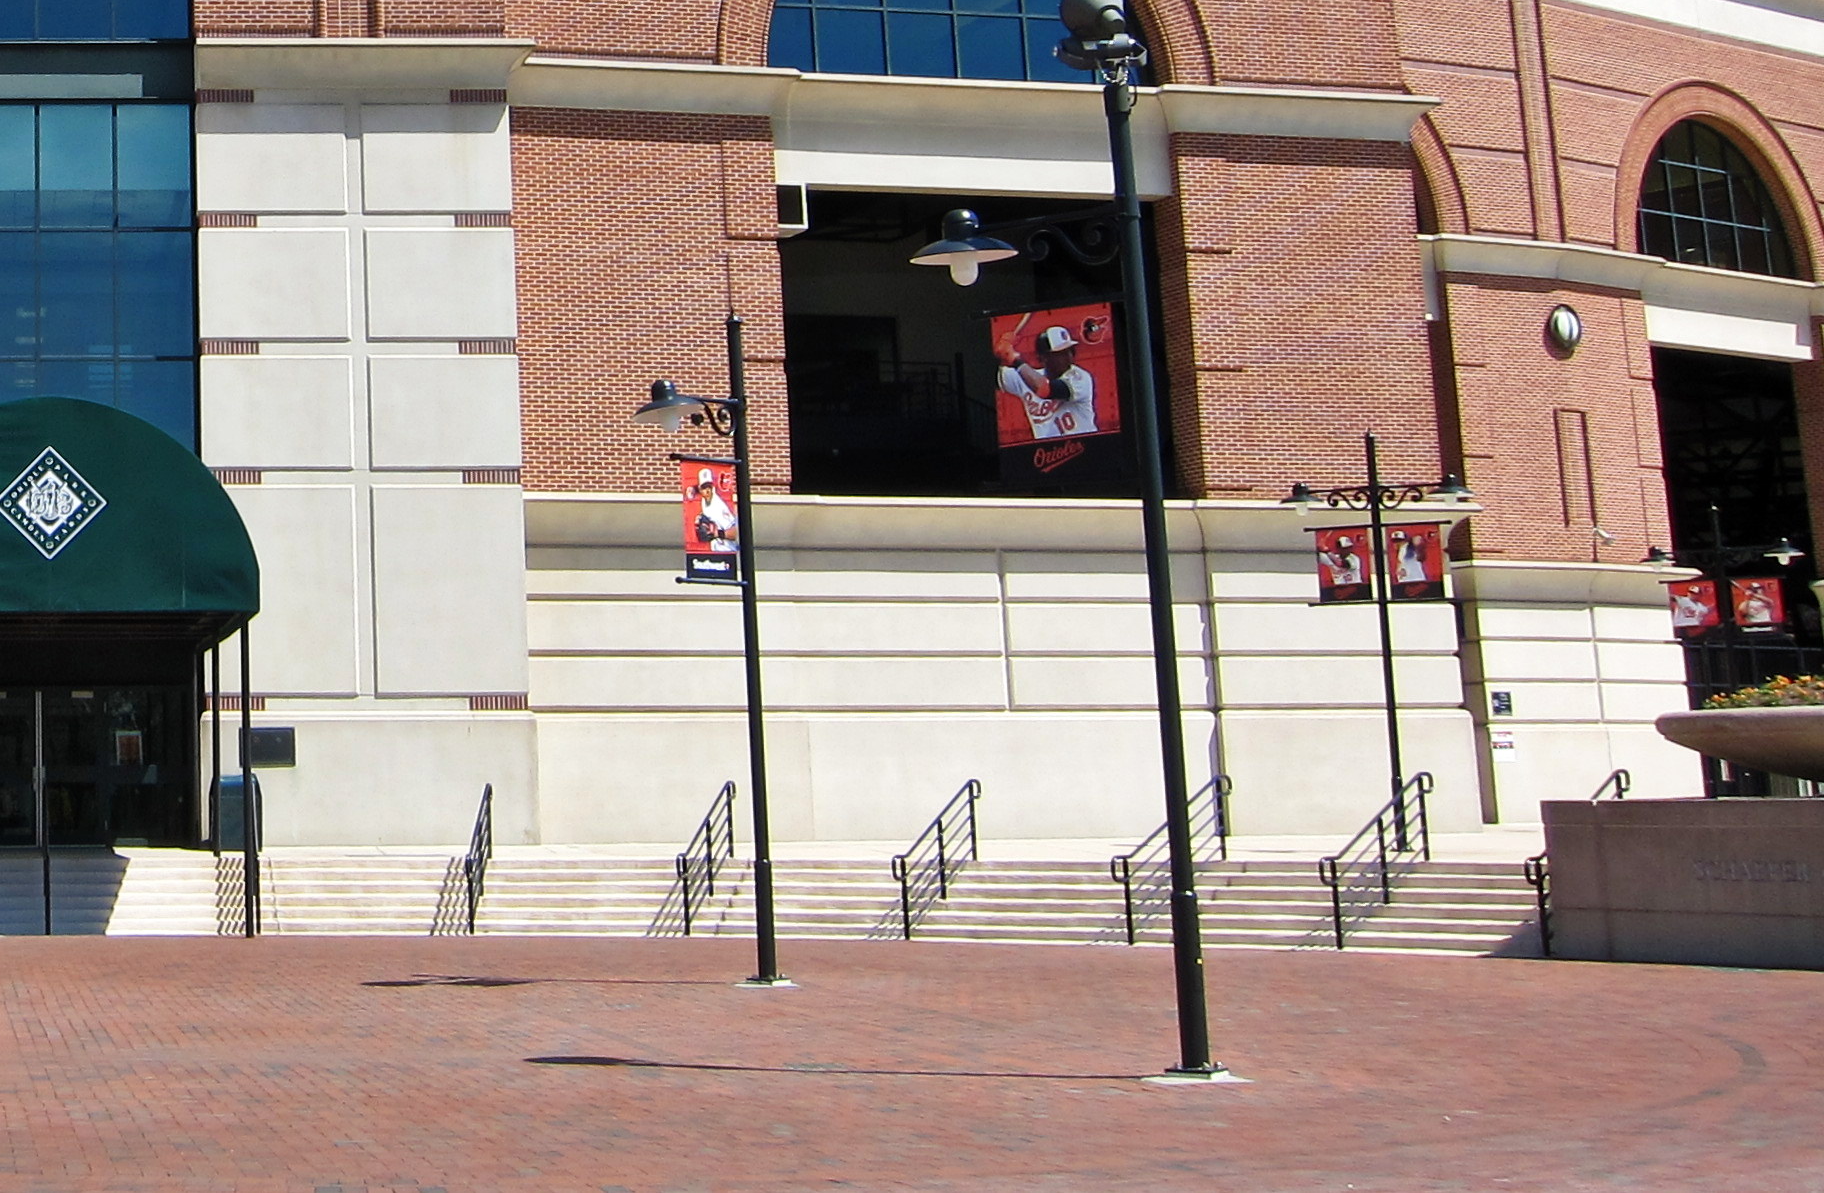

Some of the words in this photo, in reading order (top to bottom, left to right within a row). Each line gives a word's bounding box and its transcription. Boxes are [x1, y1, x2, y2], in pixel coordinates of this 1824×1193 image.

[1054, 412, 1076, 436] 10
[1034, 441, 1085, 472] Orioles
[11, 465, 44, 498] ORIOLE
[10, 507, 46, 543] CAMDEN
